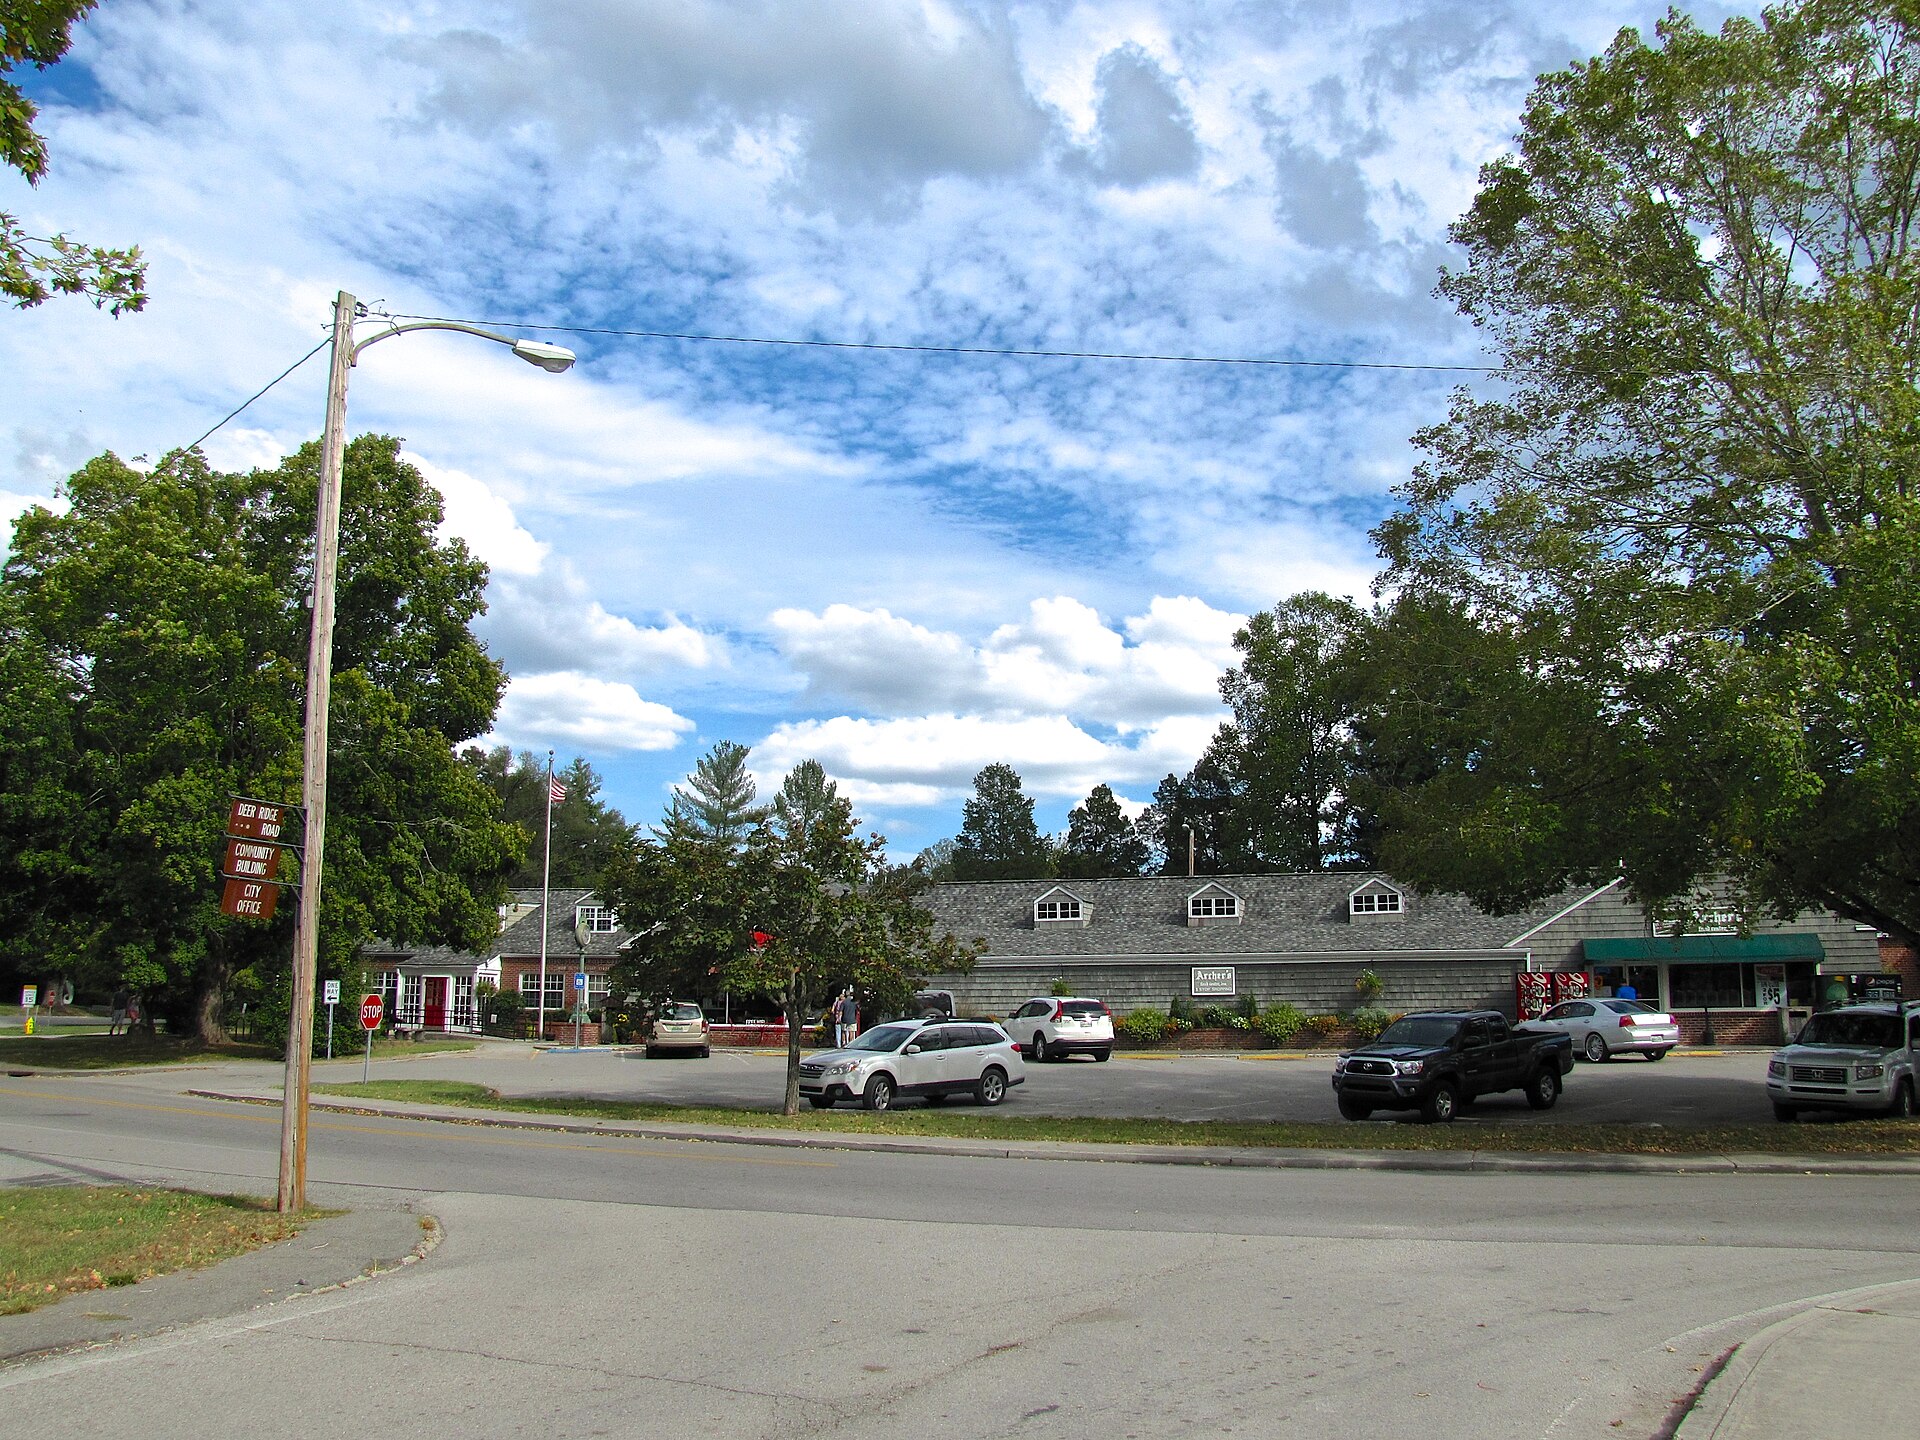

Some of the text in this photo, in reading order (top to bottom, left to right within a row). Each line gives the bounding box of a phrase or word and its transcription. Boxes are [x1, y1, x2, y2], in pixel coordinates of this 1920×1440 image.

[238, 803, 279, 822] DEER RIDGE
[261, 823, 280, 838] ROAD
[235, 843, 275, 860] COMMUNITY
[236, 860, 267, 875] BUILDING
[244, 884, 262, 898] CITY
[237, 900, 262, 914] OFFICE
[1195, 970, 1232, 981] Archer's
[1767, 987, 1780, 1005] $5
[363, 1005, 382, 1018] STOP
